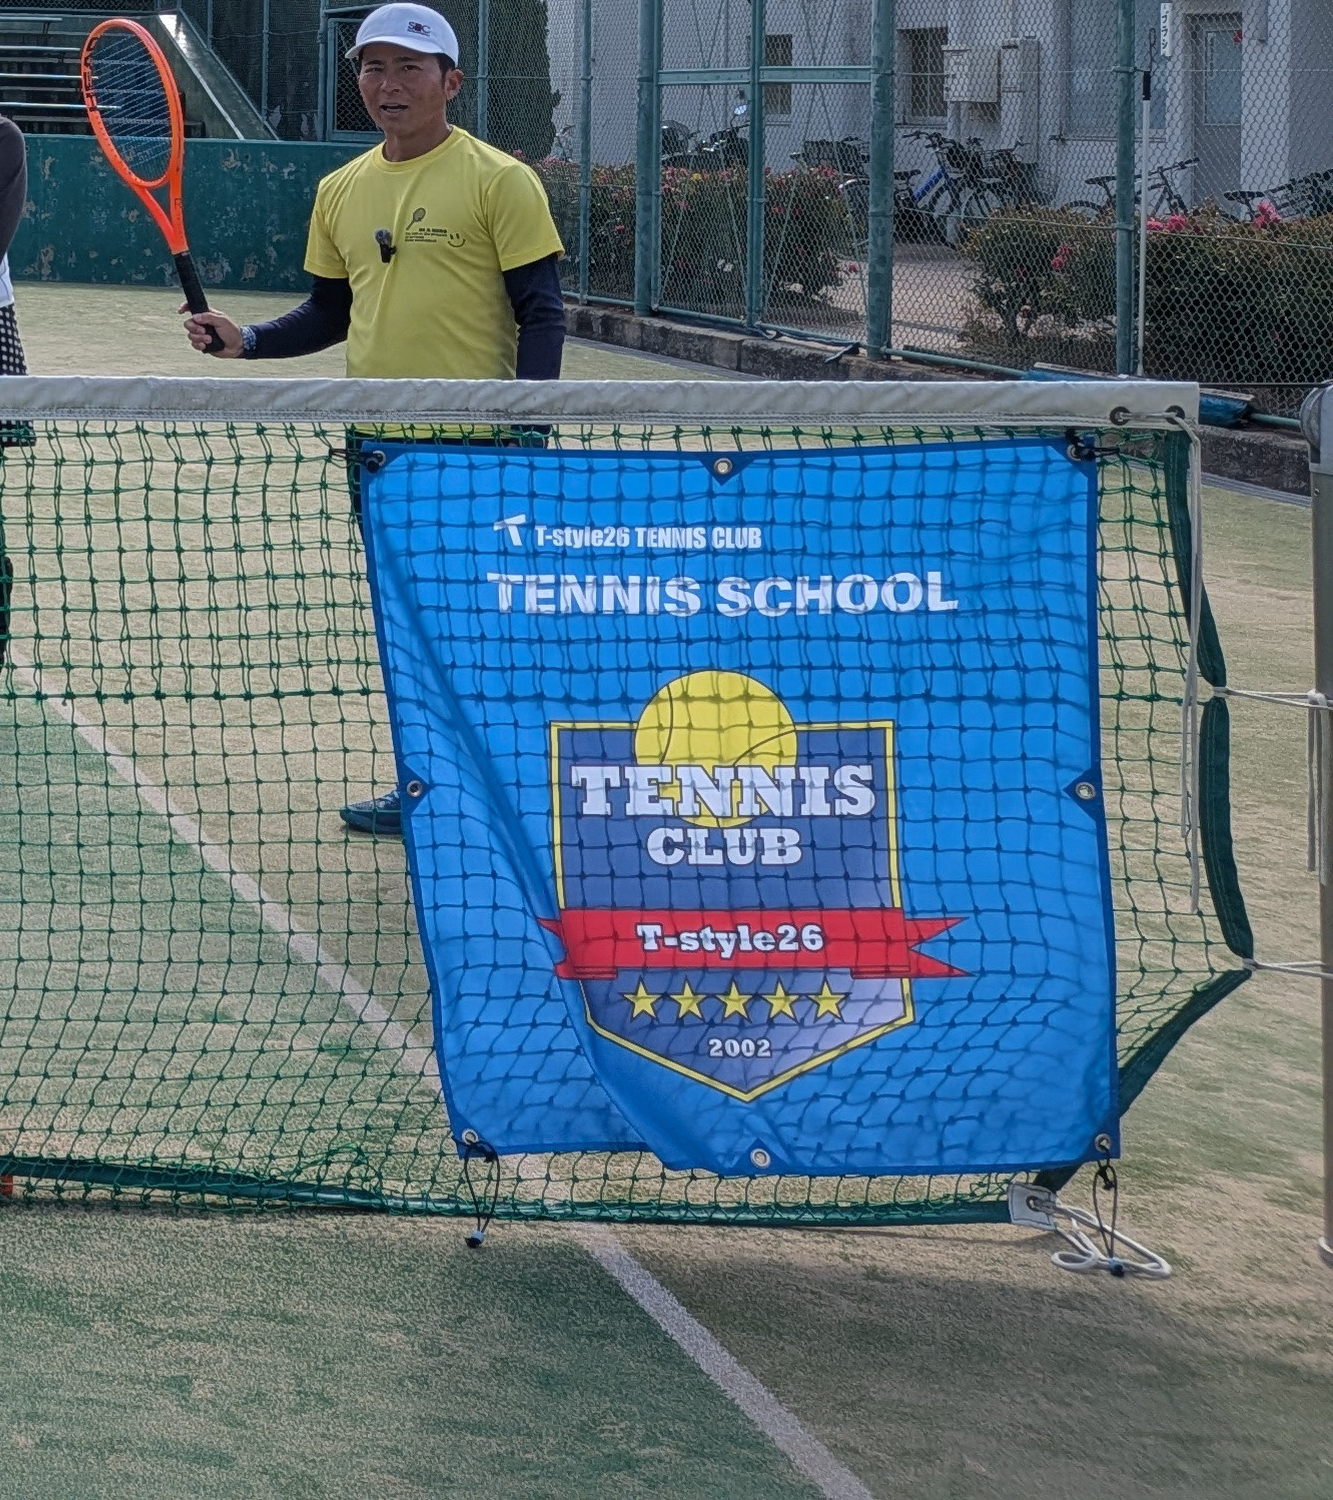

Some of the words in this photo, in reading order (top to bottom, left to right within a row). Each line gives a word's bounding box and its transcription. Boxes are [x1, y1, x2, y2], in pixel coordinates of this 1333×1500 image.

[534, 525, 630, 549] T-style26
[635, 527, 707, 549] TENNIS
[711, 527, 762, 549] CLUB
[486, 572, 701, 617] TENNIS
[716, 571, 959, 617] SCHOOL
[571, 764, 876, 817] TENNIS
[647, 827, 802, 865] CLUB
[636, 924, 825, 959] T-style26
[708, 1038, 772, 1058] 2002
